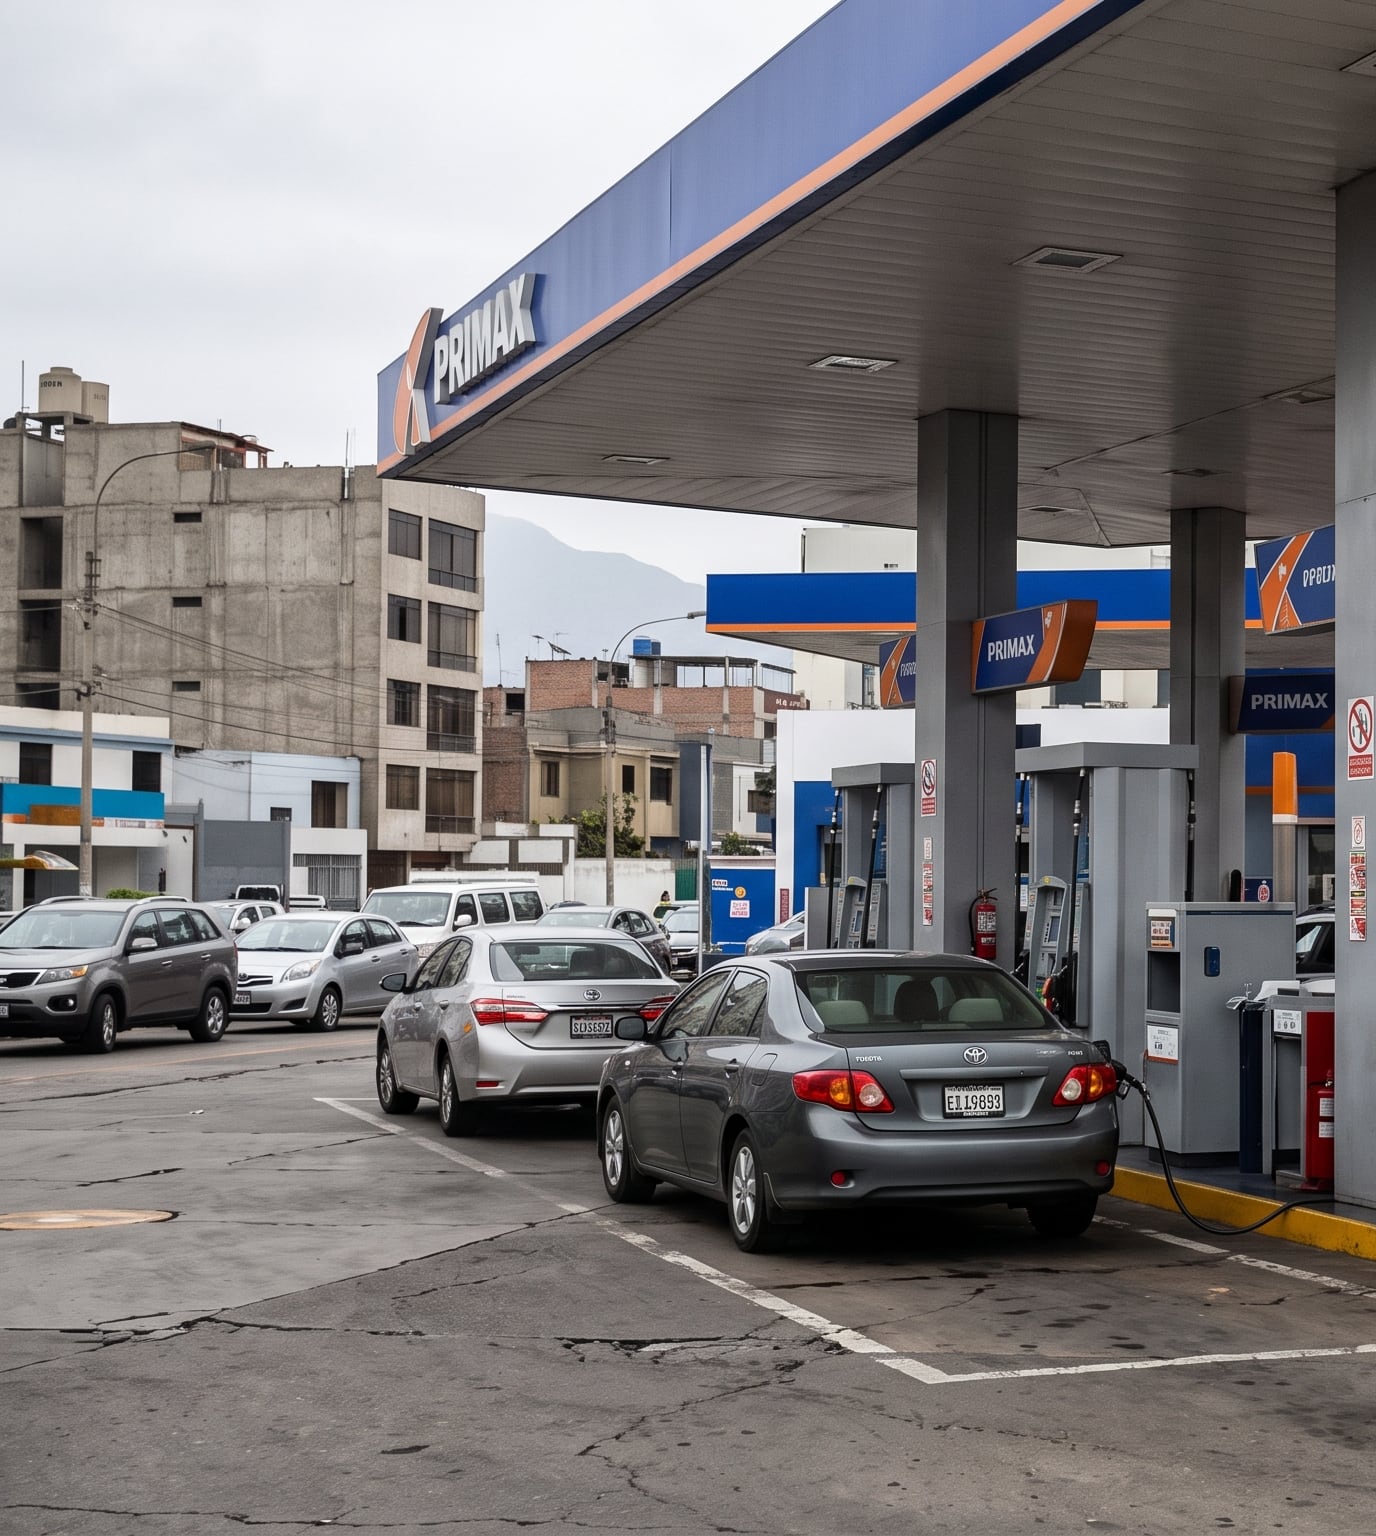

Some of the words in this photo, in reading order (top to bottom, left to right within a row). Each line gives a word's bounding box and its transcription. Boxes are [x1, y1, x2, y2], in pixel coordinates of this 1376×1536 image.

[434, 272, 537, 405] PRIMAX
[987, 634, 1035, 662] PRIMAX
[1251, 692, 1328, 710] PRIMAX
